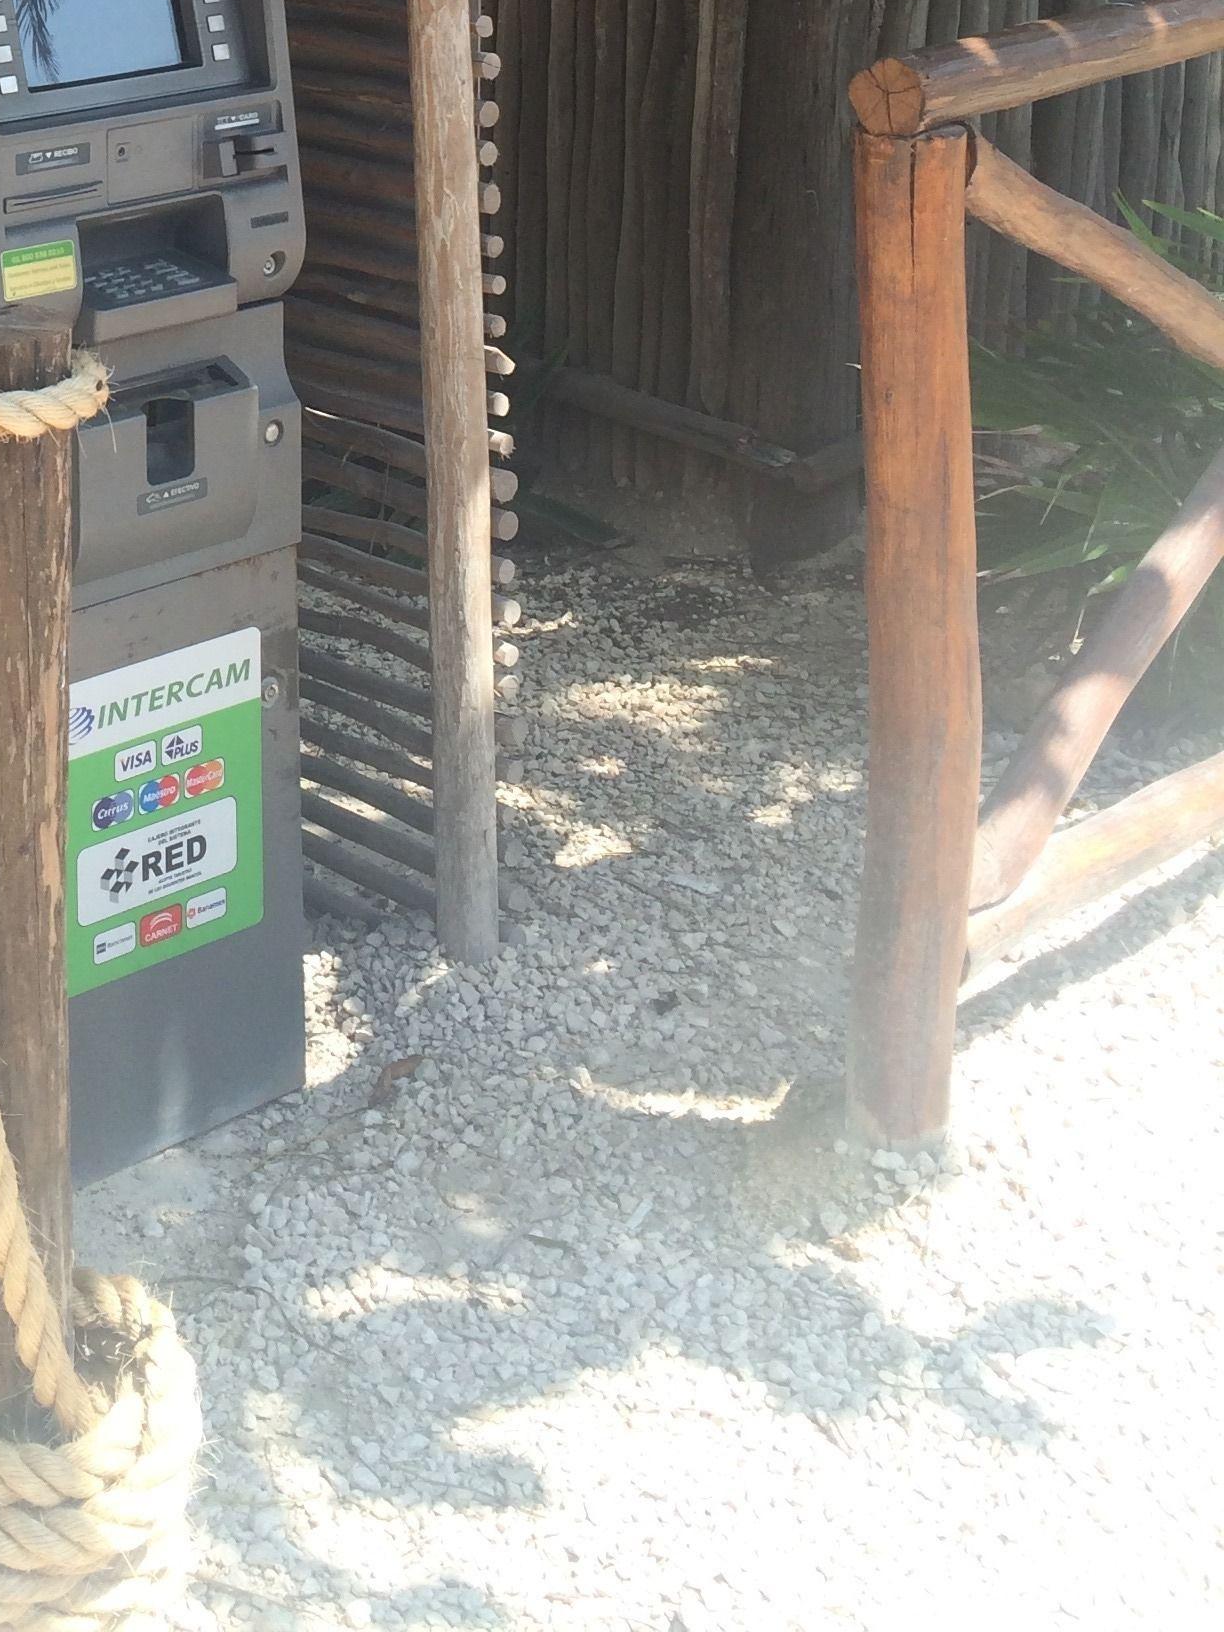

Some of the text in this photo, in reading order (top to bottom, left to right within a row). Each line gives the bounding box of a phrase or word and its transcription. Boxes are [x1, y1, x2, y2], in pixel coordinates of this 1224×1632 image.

[97, 658, 251, 729] INTERCAM
[120, 740, 199, 772] VISA PLUS
[97, 802, 129, 820] Cirrus
[143, 786, 176, 803] Maestro
[142, 834, 207, 882] RED
[144, 923, 179, 943] CARNET
